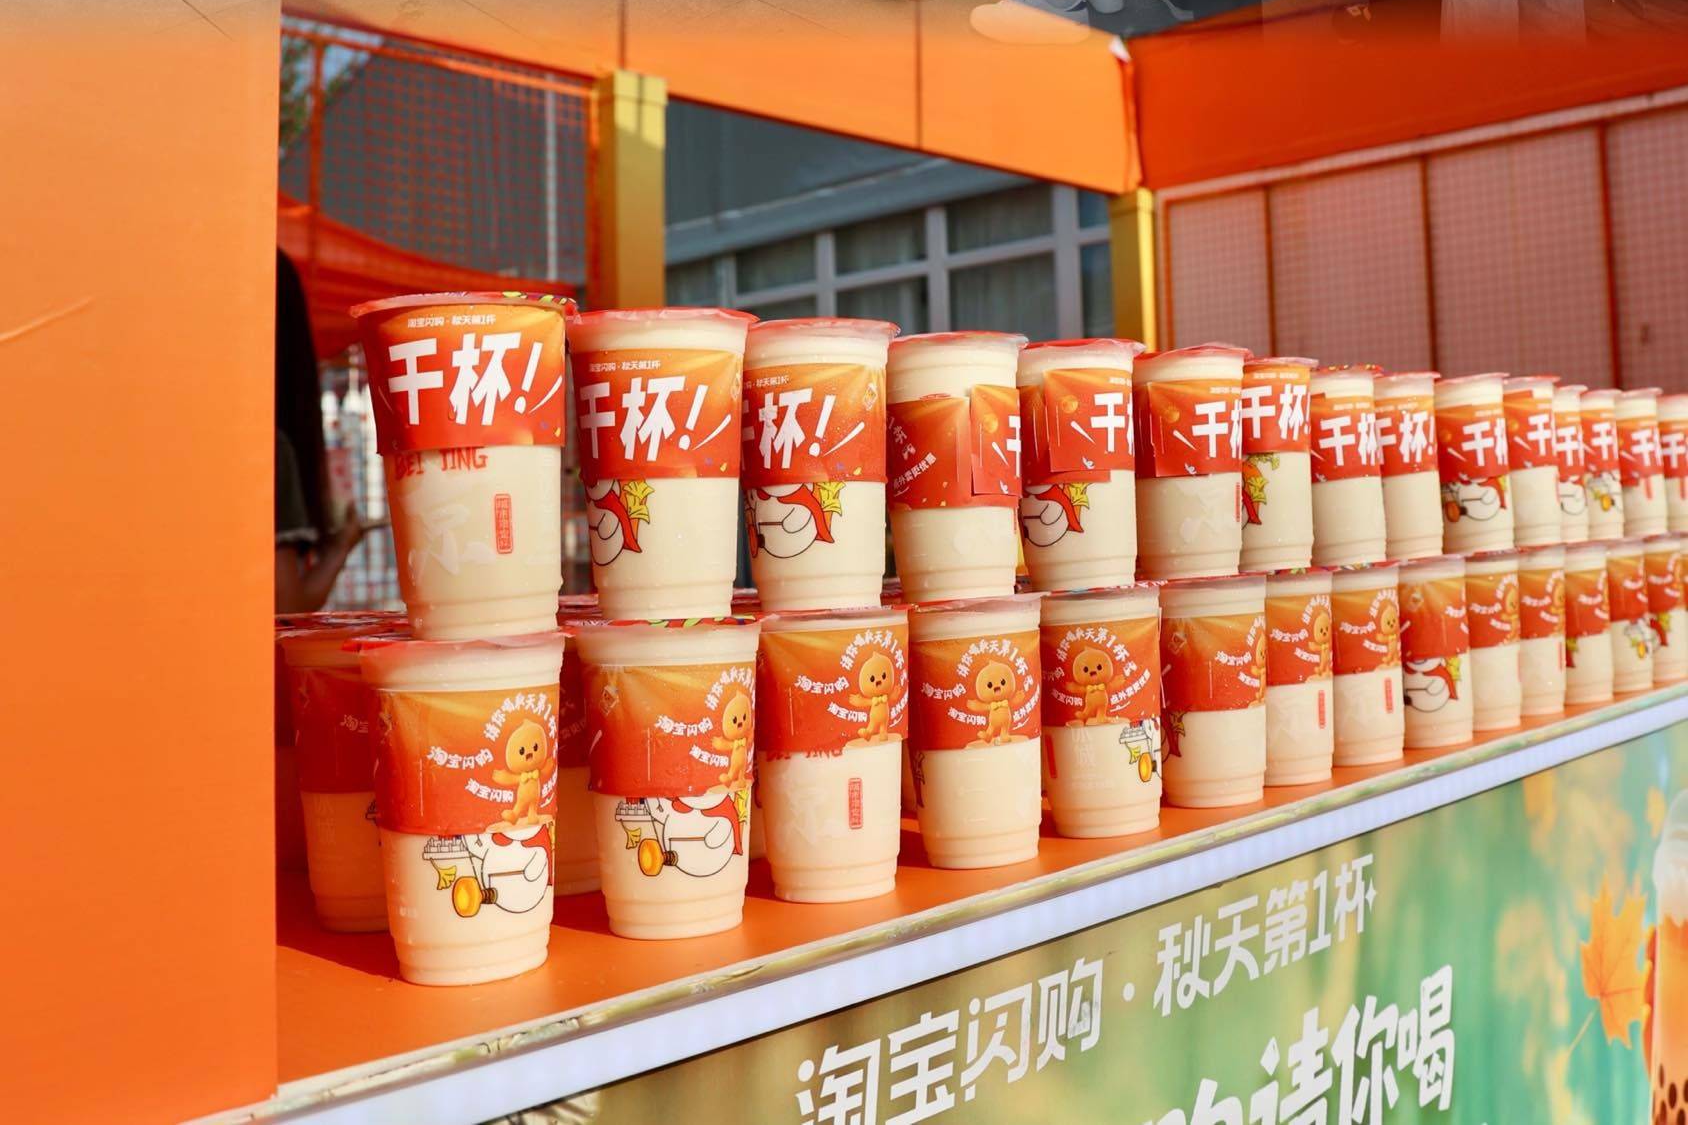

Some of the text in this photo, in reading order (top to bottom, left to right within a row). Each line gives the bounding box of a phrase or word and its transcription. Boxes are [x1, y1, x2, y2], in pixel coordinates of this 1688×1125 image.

[387, 331, 545, 426] 干杯!
[580, 375, 708, 462] 干杯!
[794, 674, 849, 695] 淘宝闪购
[921, 682, 967, 701] 淘宝闪购
[827, 701, 868, 722] 淘宝闪购
[654, 714, 713, 737] 淘宝闪购
[427, 745, 494, 770] 淘宝闪购
[465, 777, 514, 804] 淘宝闪购
